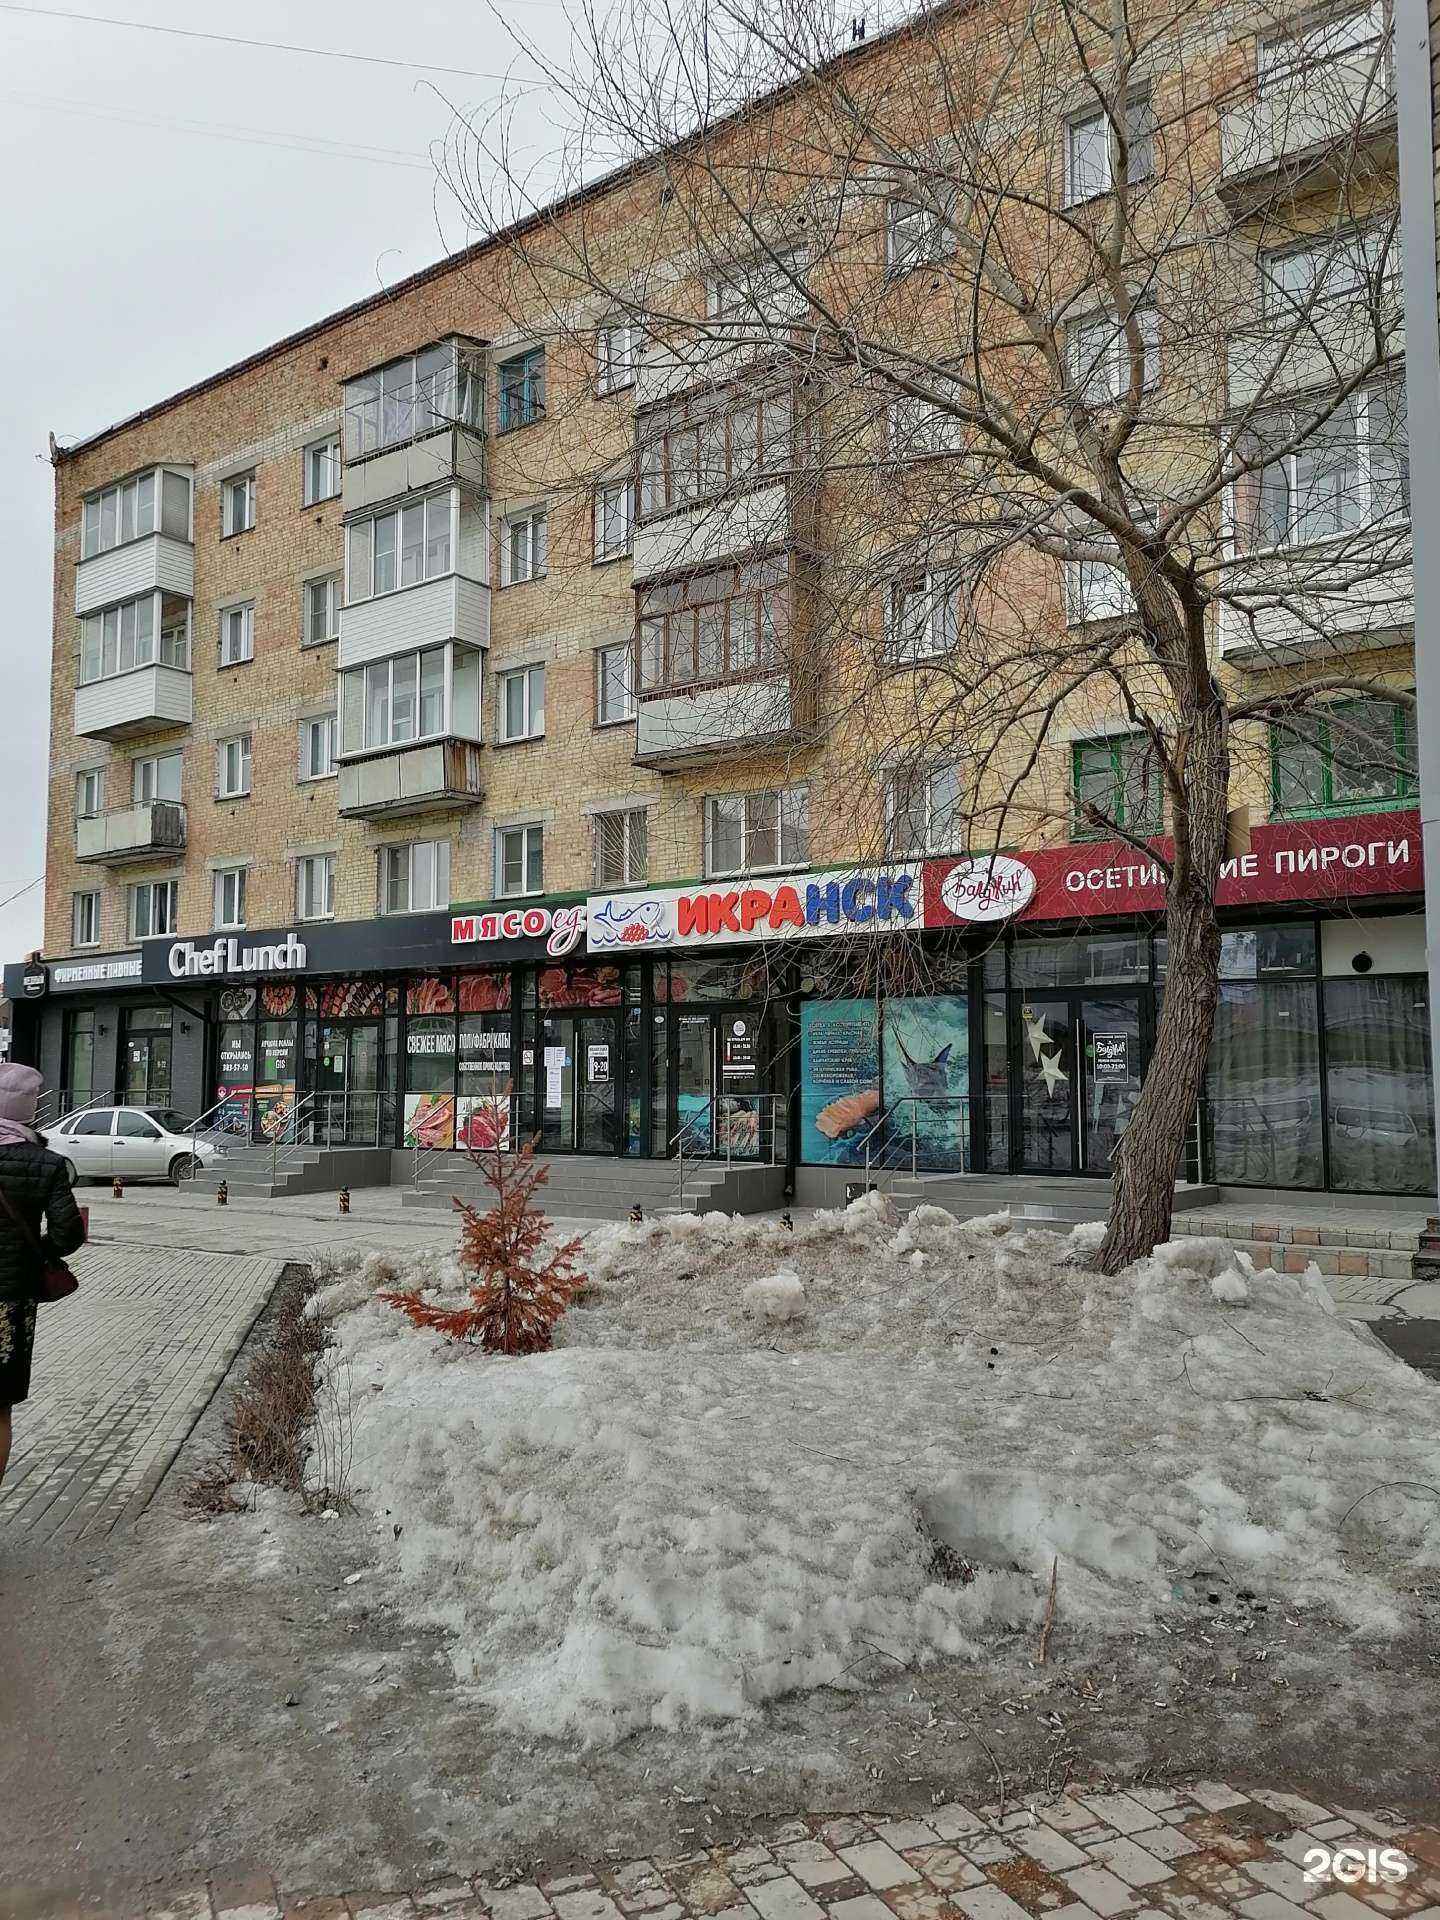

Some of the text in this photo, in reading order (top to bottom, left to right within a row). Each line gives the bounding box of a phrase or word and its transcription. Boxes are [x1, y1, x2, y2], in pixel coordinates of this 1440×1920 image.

[1066, 839, 1410, 892] ОСЕТИИЕ ПИРОГИ
[407, 1034, 456, 1054] СВЕЖЕЕ МЯСО
